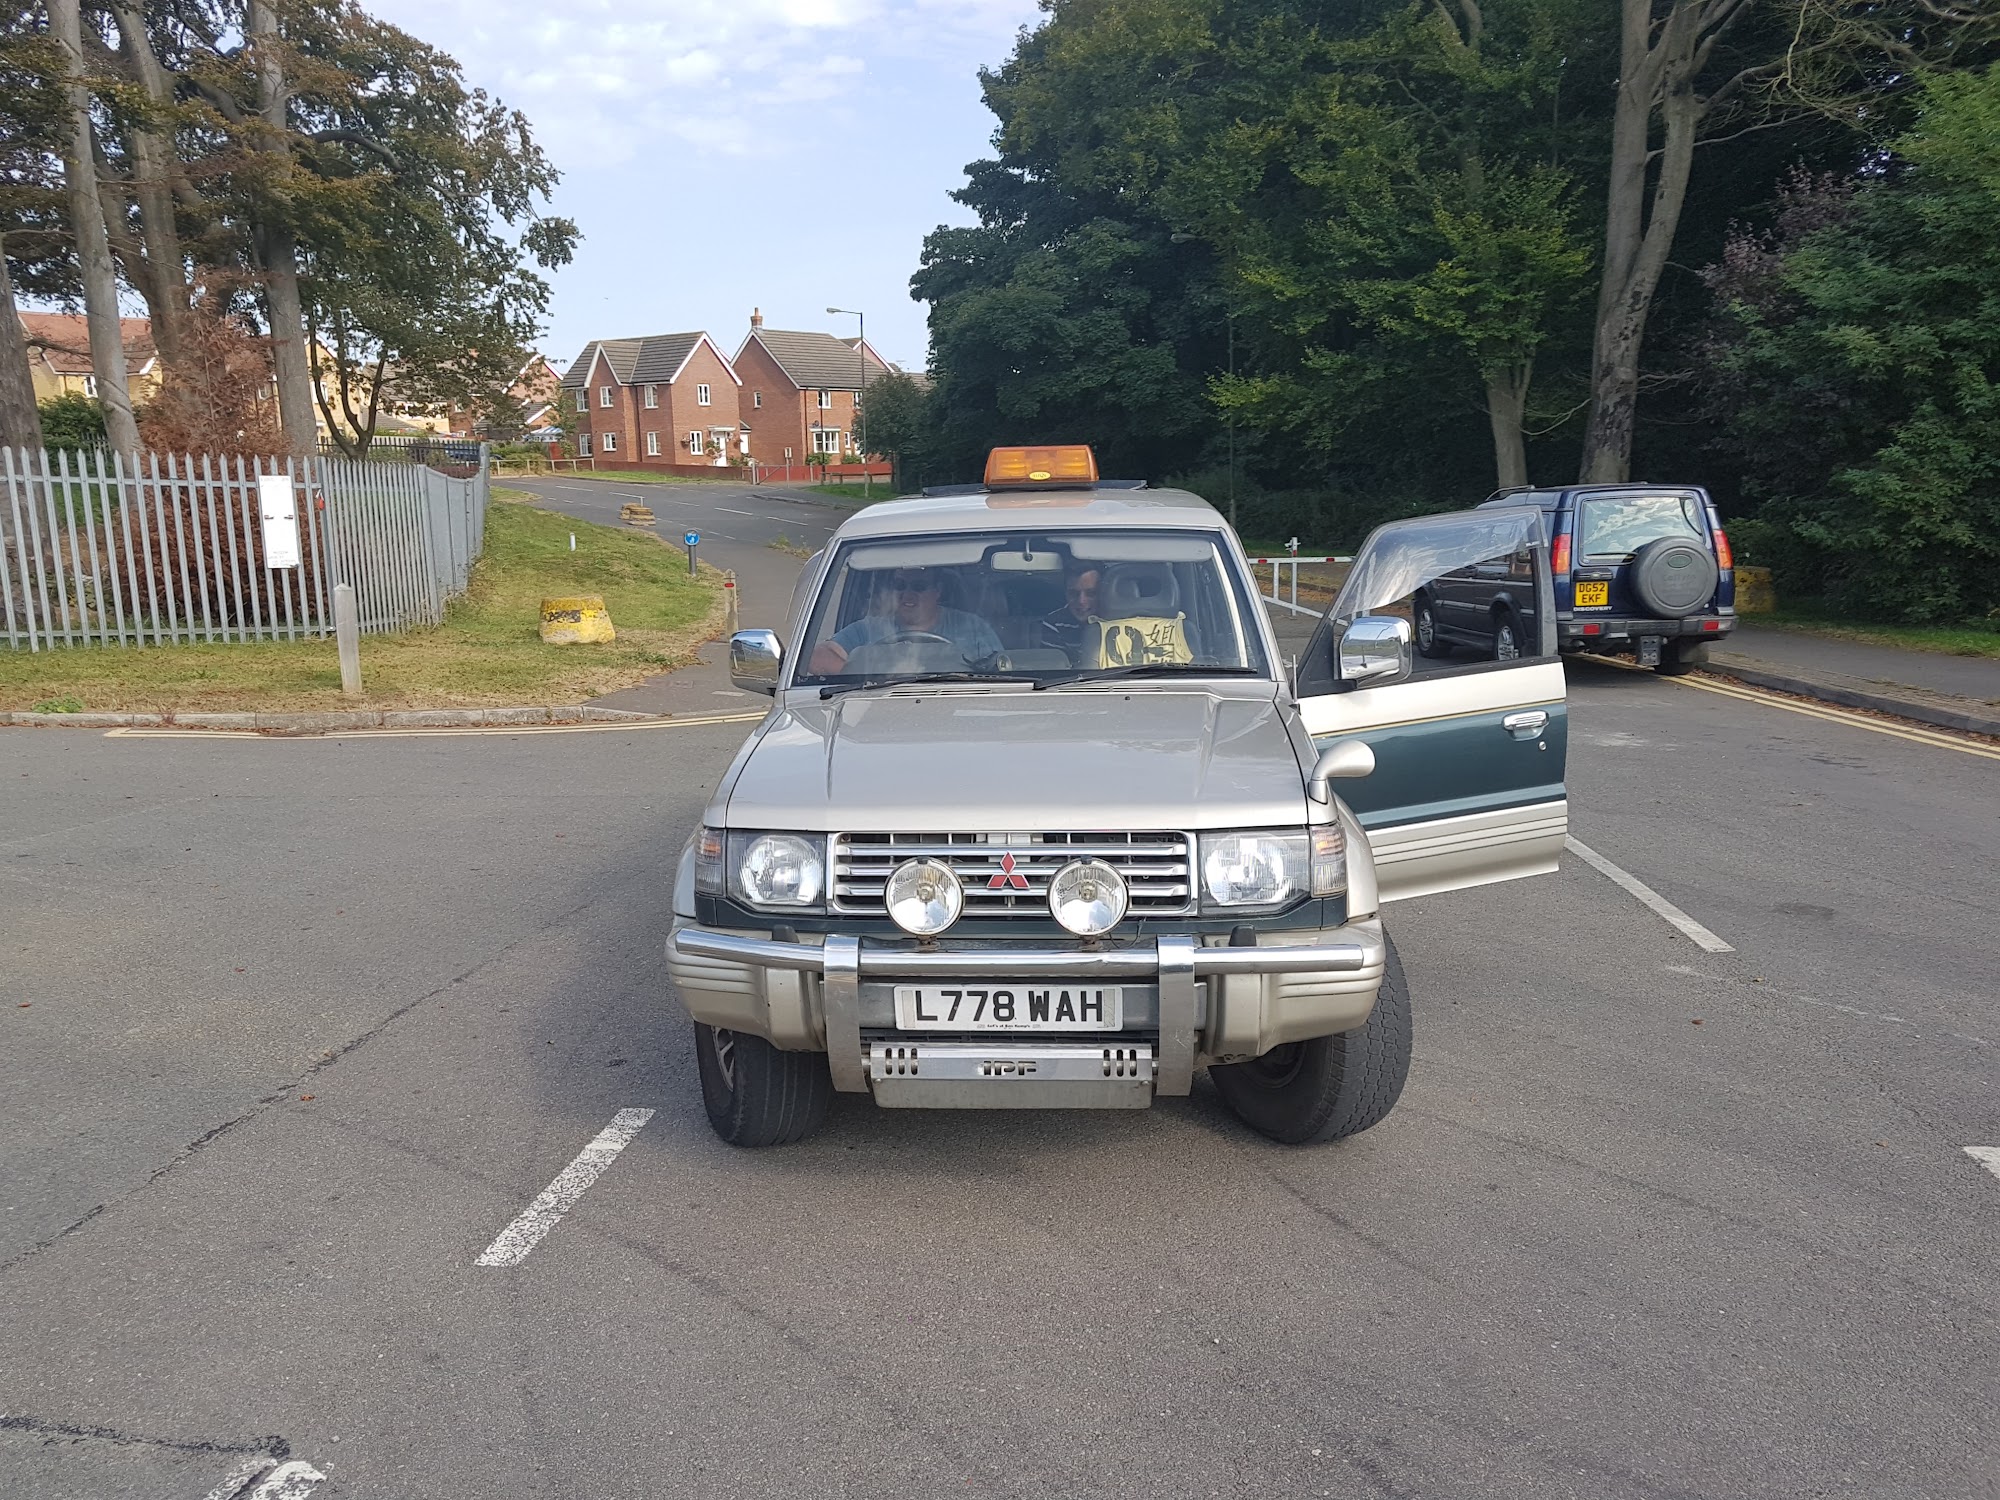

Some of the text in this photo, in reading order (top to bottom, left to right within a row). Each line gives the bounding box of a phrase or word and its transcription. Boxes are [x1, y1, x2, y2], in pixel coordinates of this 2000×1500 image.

[1579, 583, 1605, 592] DG52
[1582, 594, 1601, 603] EKF
[915, 990, 1102, 1021] L778 WAH
[984, 1061, 1036, 1075] IPF
